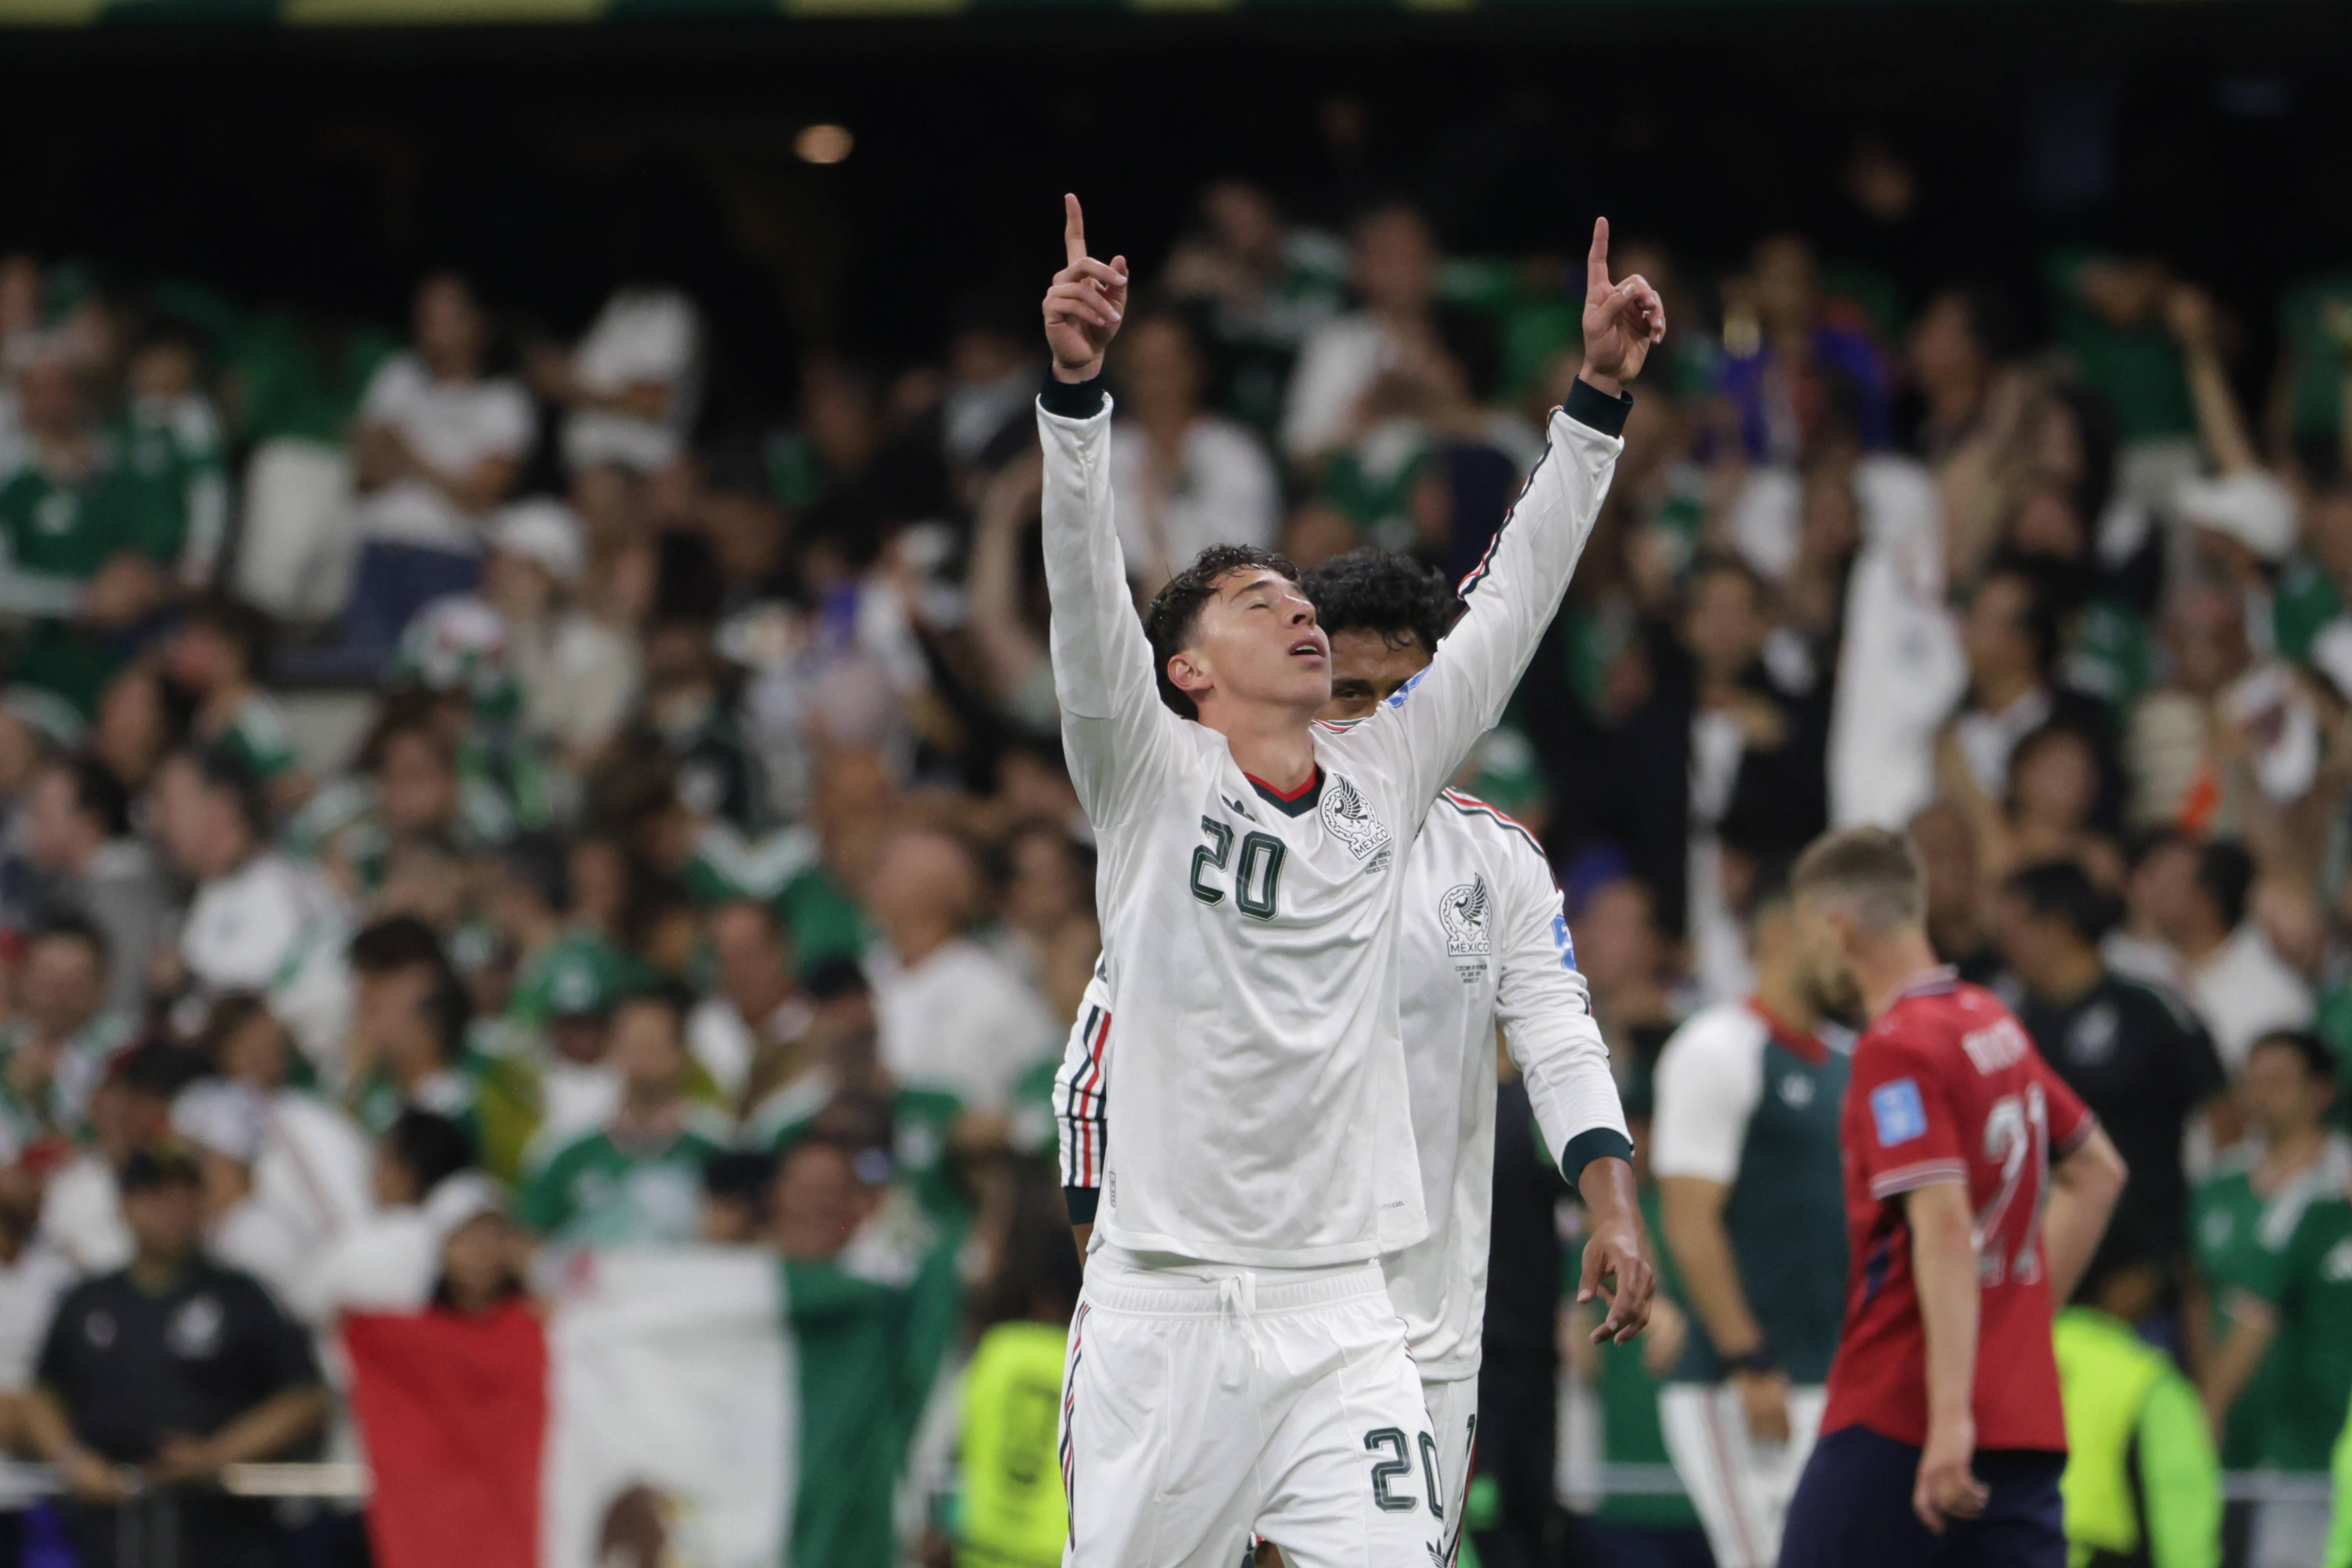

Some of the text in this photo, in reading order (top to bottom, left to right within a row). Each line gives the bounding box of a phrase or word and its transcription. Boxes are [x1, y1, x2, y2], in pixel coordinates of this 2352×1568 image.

[1190, 815, 1288, 922] 20
[1354, 829, 1388, 856] MÉXICO
[1450, 940, 1489, 953] MÉXICO
[1363, 1427, 1444, 1523] 20
